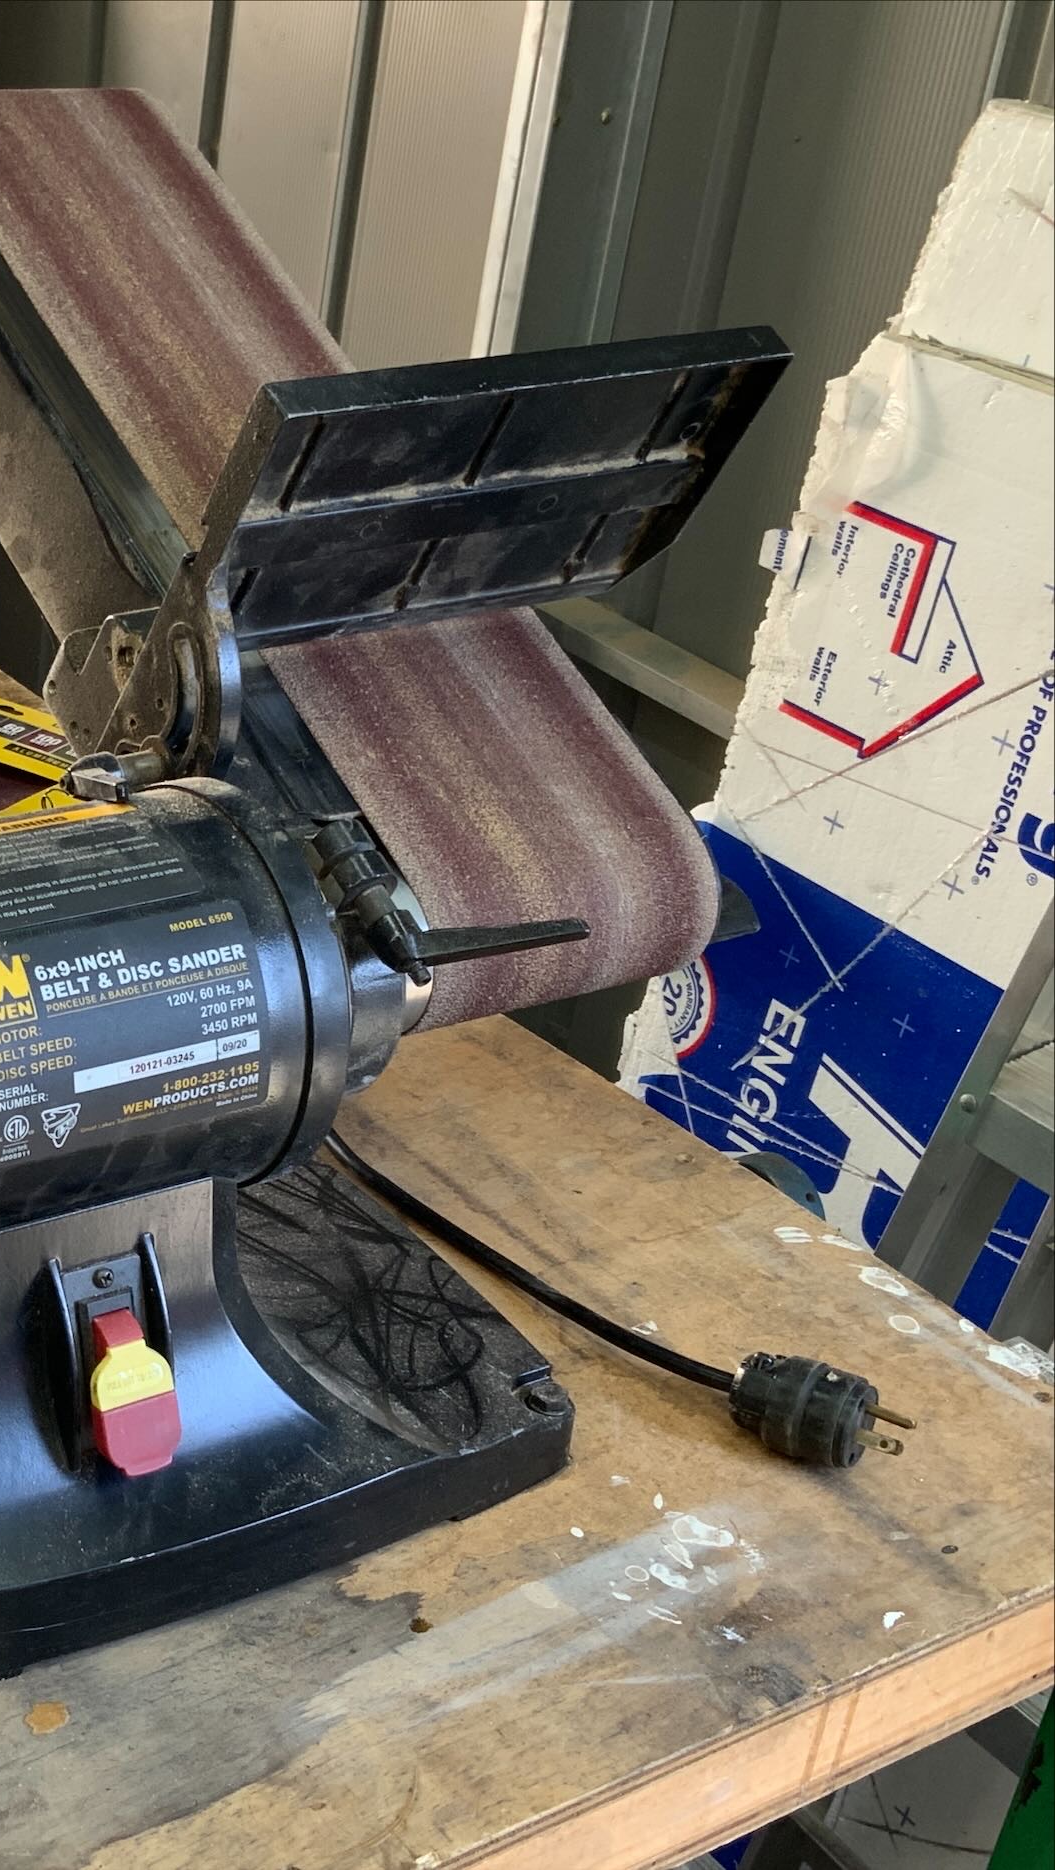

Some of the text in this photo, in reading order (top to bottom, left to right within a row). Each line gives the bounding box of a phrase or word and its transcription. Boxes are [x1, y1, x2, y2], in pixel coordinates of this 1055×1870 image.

[831, 521, 847, 556] walls
[837, 525, 859, 578] Interior
[880, 543, 904, 599] Ceilings
[887, 548, 916, 618] Cathedral
[809, 646, 825, 682] walls
[939, 640, 957, 674] Attic
[813, 651, 837, 706] Exterior
[975, 704, 1048, 878] PROFESSIONALS
[24, 882, 51, 891] sanding
[3, 910, 18, 918] may
[169, 912, 234, 932] MODEL 6508
[34, 949, 126, 982] 6x9-INCH
[40, 944, 247, 1002] BELT & DISC SANDER
[46, 993, 97, 1013] PONCEUSE
[109, 984, 140, 1000] BANDE
[142, 982, 153, 993] ET
[155, 971, 205, 989] PONCEUSE
[215, 962, 249, 976] DISQUE
[167, 978, 253, 1008] 120V, 60 Hz, 9A
[200, 995, 256, 1018] 2700 FPM
[674, 982, 694, 1028] WARRANTY
[201, 1012, 258, 1036] 3450 RPM
[29, 1036, 77, 1056] SPEED:
[222, 1038, 247, 1053] 09/20
[31, 1054, 77, 1075] SPEED:
[129, 1050, 195, 1076] 120121-03245
[161, 1060, 260, 1094] 1-800-232-1195
[0, 1092, 49, 1112] NUMBER:
[123, 1073, 259, 1116] WENPRODUCTS.COM
[215, 1098, 232, 1107] Made
[240, 1093, 257, 1101] China
